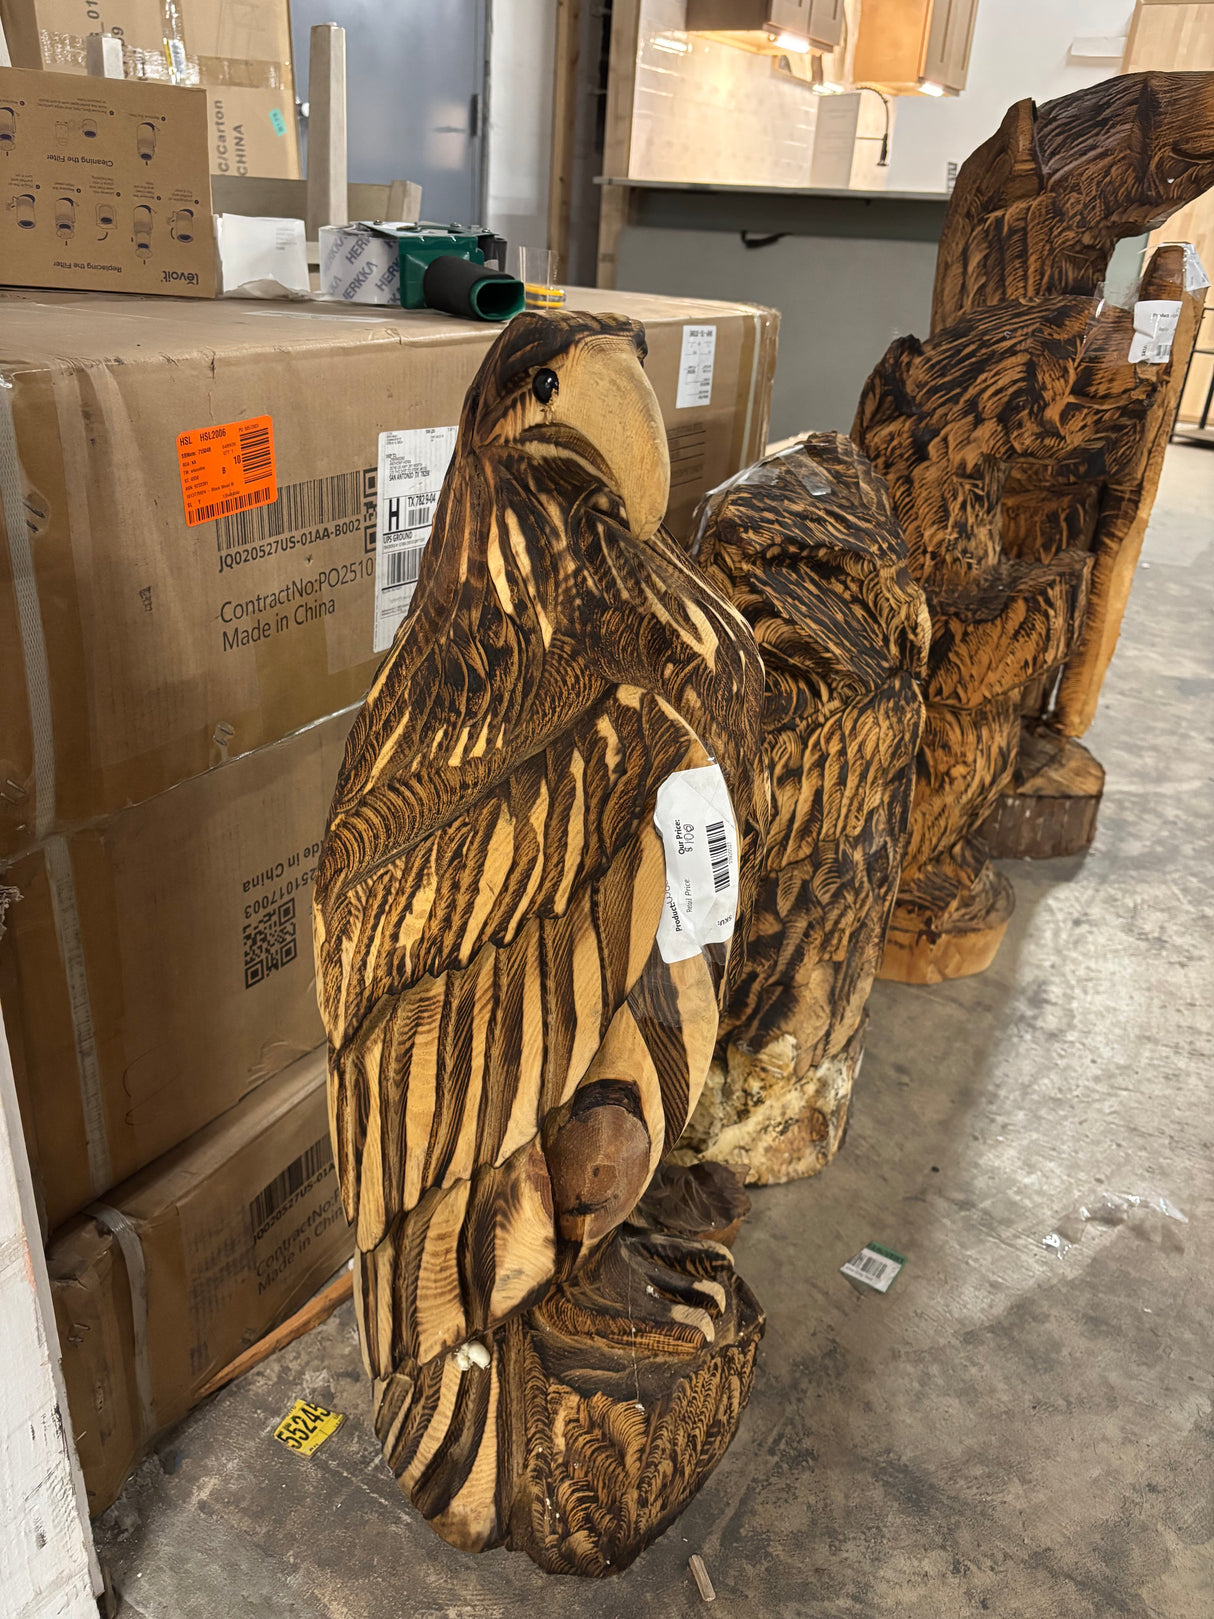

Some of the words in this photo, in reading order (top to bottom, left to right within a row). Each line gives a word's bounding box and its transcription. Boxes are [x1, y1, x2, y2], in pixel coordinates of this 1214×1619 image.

[46, 154, 65, 162] Filter
[233, 124, 248, 176] CHINA
[67, 155, 80, 163] the
[81, 156, 113, 167] Cleaning
[53, 261, 72, 269] Filter
[87, 263, 122, 273] Replacing
[180, 436, 192, 446] HSL
[408, 496, 415, 508] TX
[388, 497, 400, 531] H
[218, 518, 361, 573] JQ020527US-01AA-B002
[383, 535, 393, 544] UPS
[393, 531, 413, 542] GROUND
[220, 558, 374, 624] ContractNo:PO2510
[222, 616, 271, 652] Made
[276, 611, 289, 632] in
[294, 597, 336, 625] China
[674, 819, 682, 840] Price:
[303, 841, 322, 858] de
[288, 852, 300, 867] in
[243, 863, 285, 893] China
[669, 901, 683, 932] Product:
[258, 1252, 295, 1296] Made
[299, 1237, 312, 1253] in
